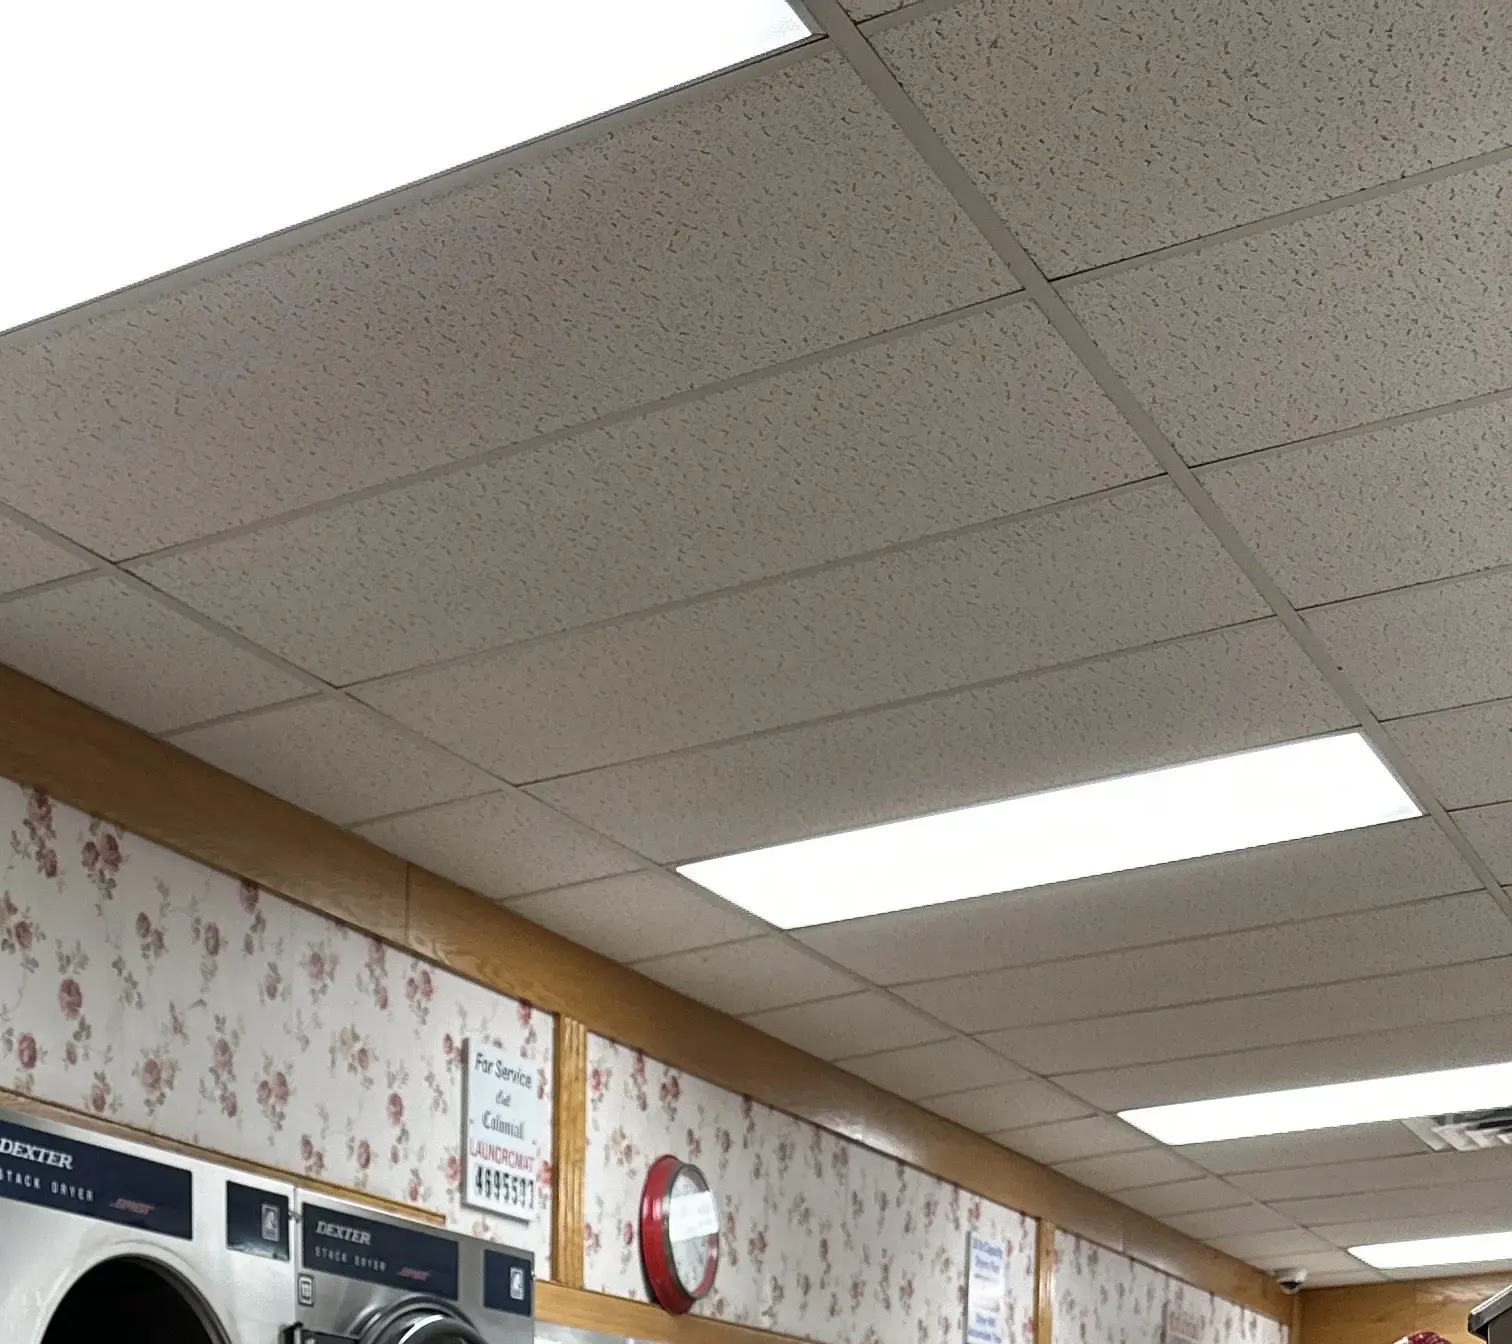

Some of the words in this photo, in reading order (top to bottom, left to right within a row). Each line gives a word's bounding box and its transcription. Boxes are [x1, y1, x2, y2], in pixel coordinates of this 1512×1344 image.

[475, 1052, 493, 1075] For
[495, 1060, 533, 1090] Service
[51, 1181, 95, 1202] DRYER
[315, 1220, 372, 1246] DEXTER
